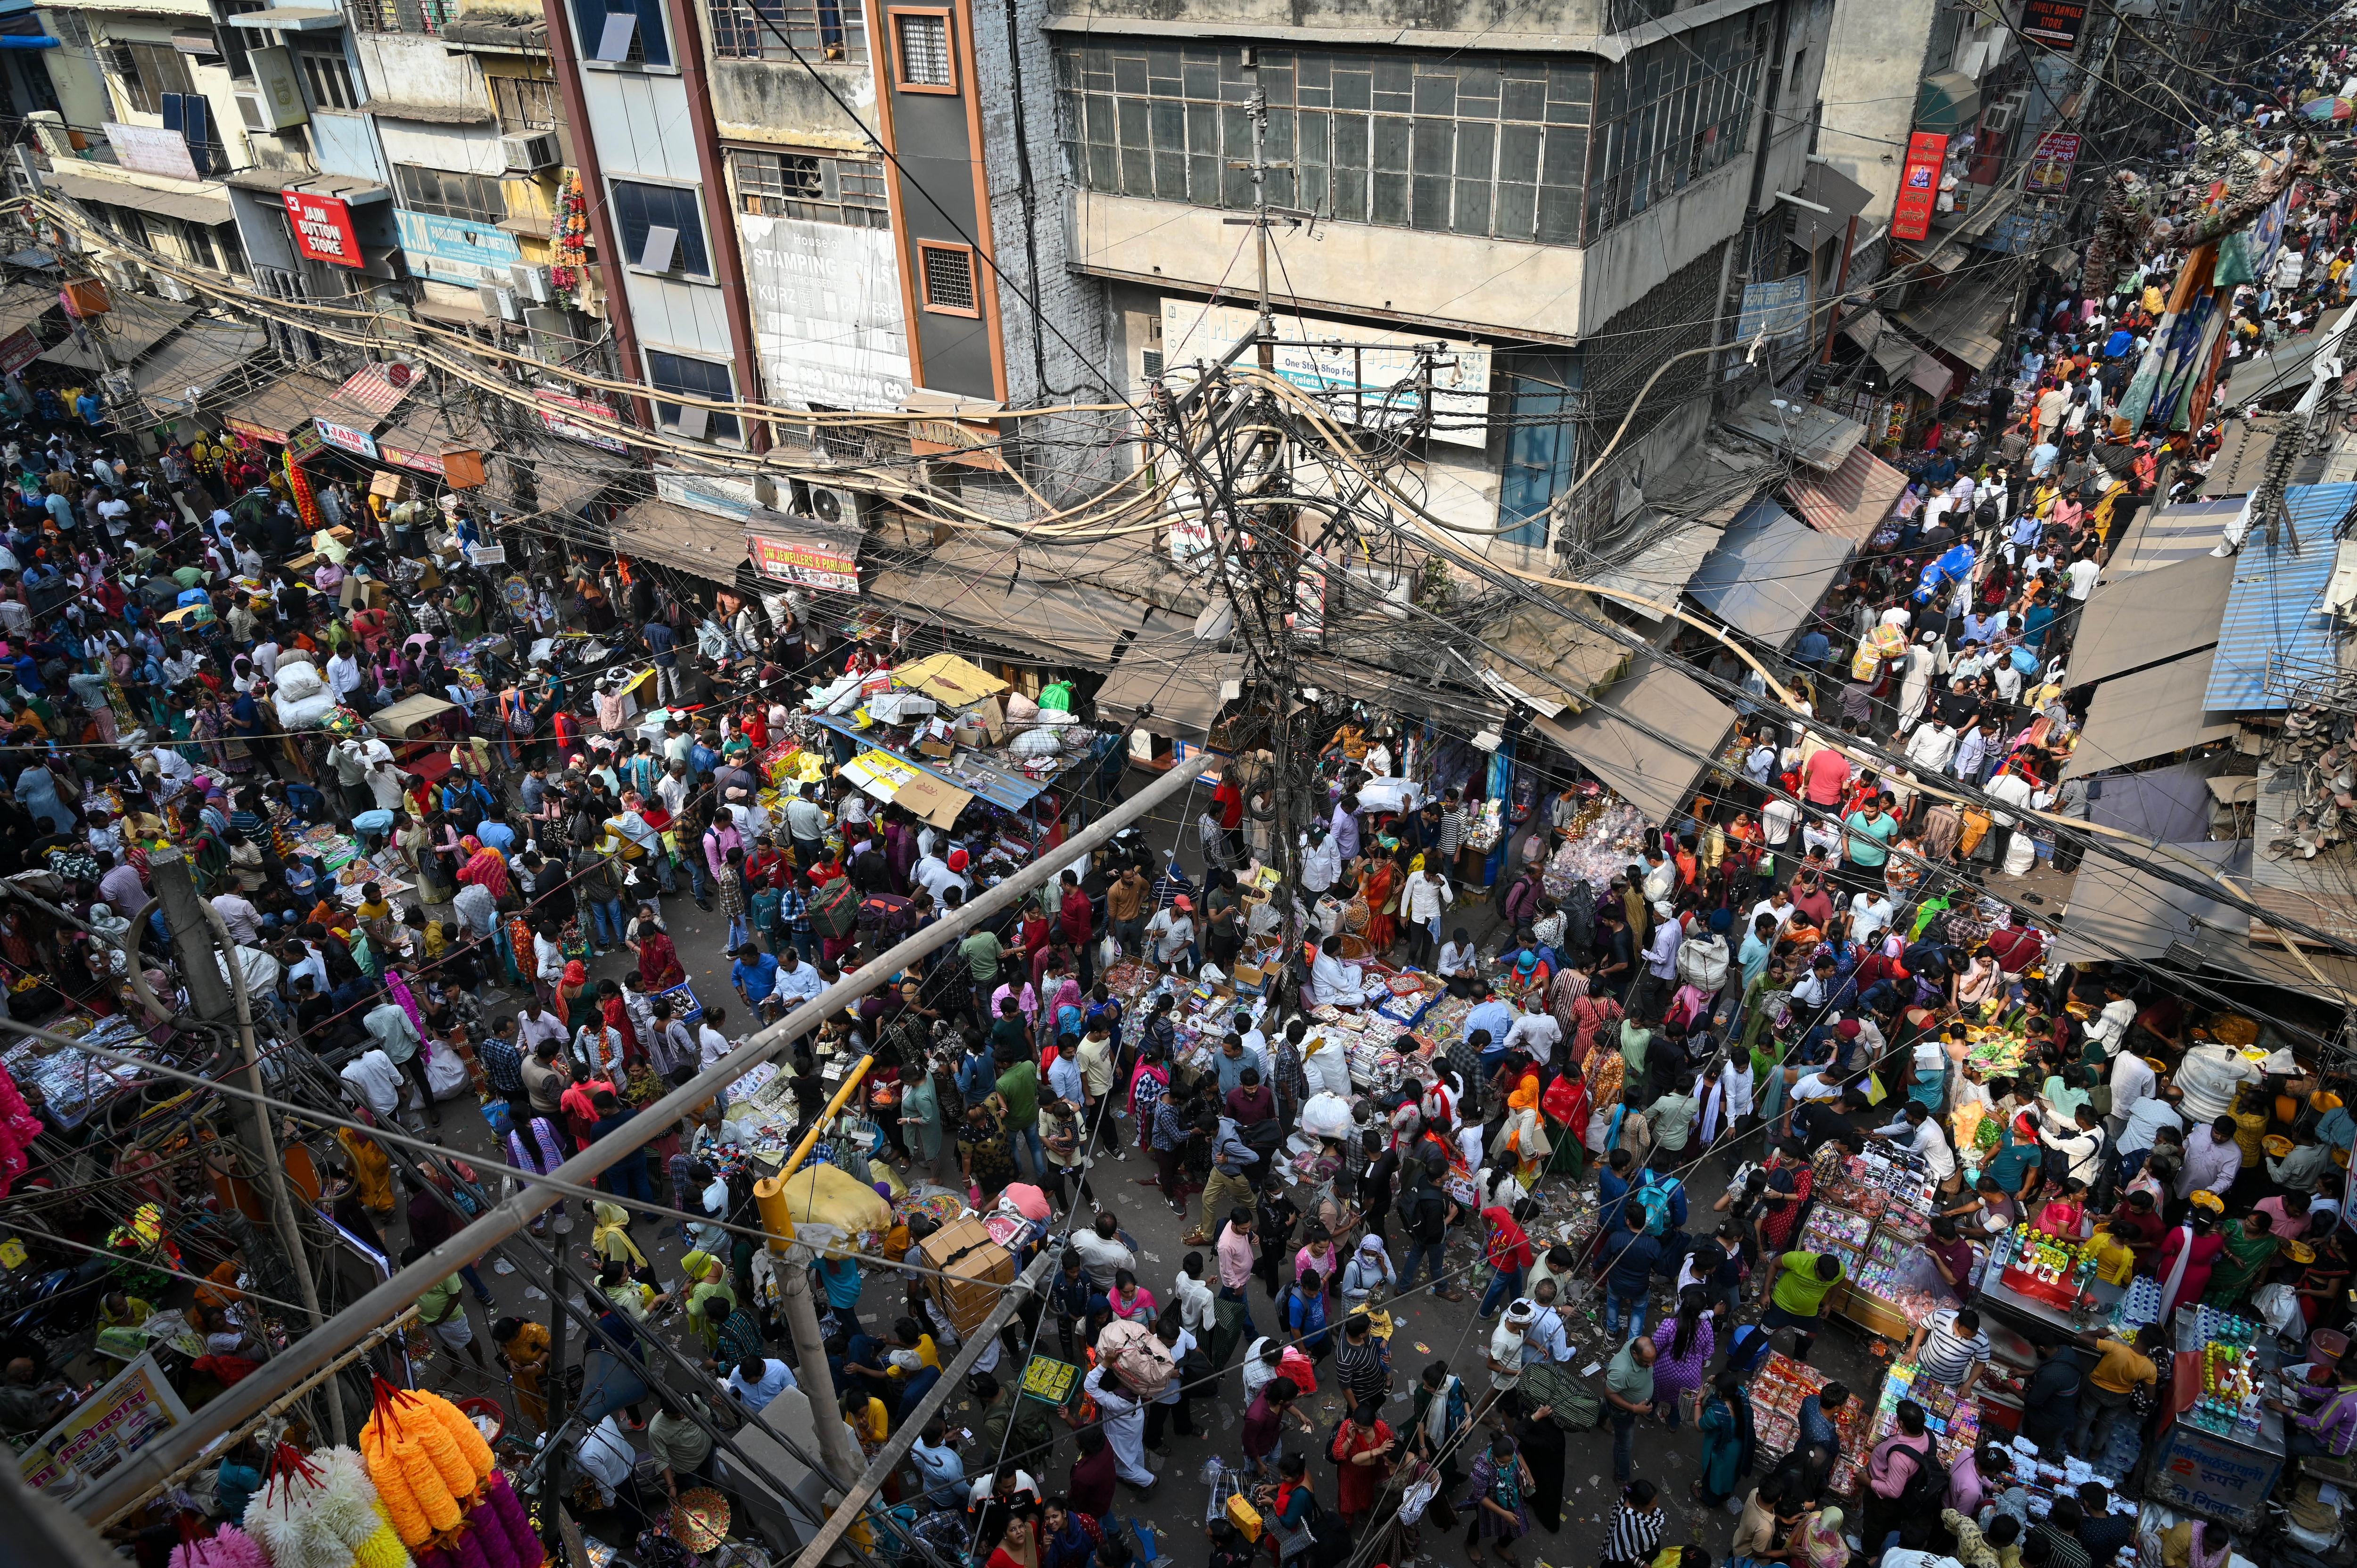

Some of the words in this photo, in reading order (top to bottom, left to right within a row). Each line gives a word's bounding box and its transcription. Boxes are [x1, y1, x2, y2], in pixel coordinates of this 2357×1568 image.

[2028, 1, 2054, 14] LOVELY
[2054, 4, 2083, 18] BANGLE
[2040, 16, 2063, 29] STORE
[1904, 191, 1929, 205] जय
[304, 205, 329, 223] JAIN
[1899, 207, 1926, 222] भोले
[298, 220, 343, 241] BUTTON
[395, 213, 437, 254] Y.M.
[308, 236, 344, 256] STORE
[430, 226, 463, 243] PARLOUR
[475, 233, 516, 254] COSMETICS
[793, 233, 828, 248] House
[753, 248, 838, 276] STAMPING
[758, 283, 798, 304] KURZ
[392, 369, 408, 381] BUTTON
[396, 366, 407, 376] JAIN
[1285, 358, 1300, 368] One
[1302, 361, 1319, 372] Stop
[1321, 364, 1340, 377] Shop
[1342, 368, 1354, 377] For
[824, 371, 882, 395] TRADING
[1288, 372, 1319, 387] Eyelets
[244, 423, 262, 434] GENERAL
[262, 427, 276, 438] STORE
[331, 426, 362, 444] JAIN
[336, 437, 350, 448] Button
[351, 443, 364, 452] Store
[384, 448, 403, 464] Y.M
[402, 454, 426, 468] PARLOUR
[683, 477, 707, 494] रोहित
[708, 485, 750, 505] कलेक्शन
[1171, 522, 1205, 539] MSPW
[764, 547, 775, 560] OM
[776, 550, 814, 567] JEWELLERS
[816, 557, 821, 568] &
[822, 558, 853, 575] PARLOUR
[2170, 1458, 2194, 1477] 2
[2200, 1469, 2248, 1491] रुपये
[2236, 1465, 2266, 1482] पानी
